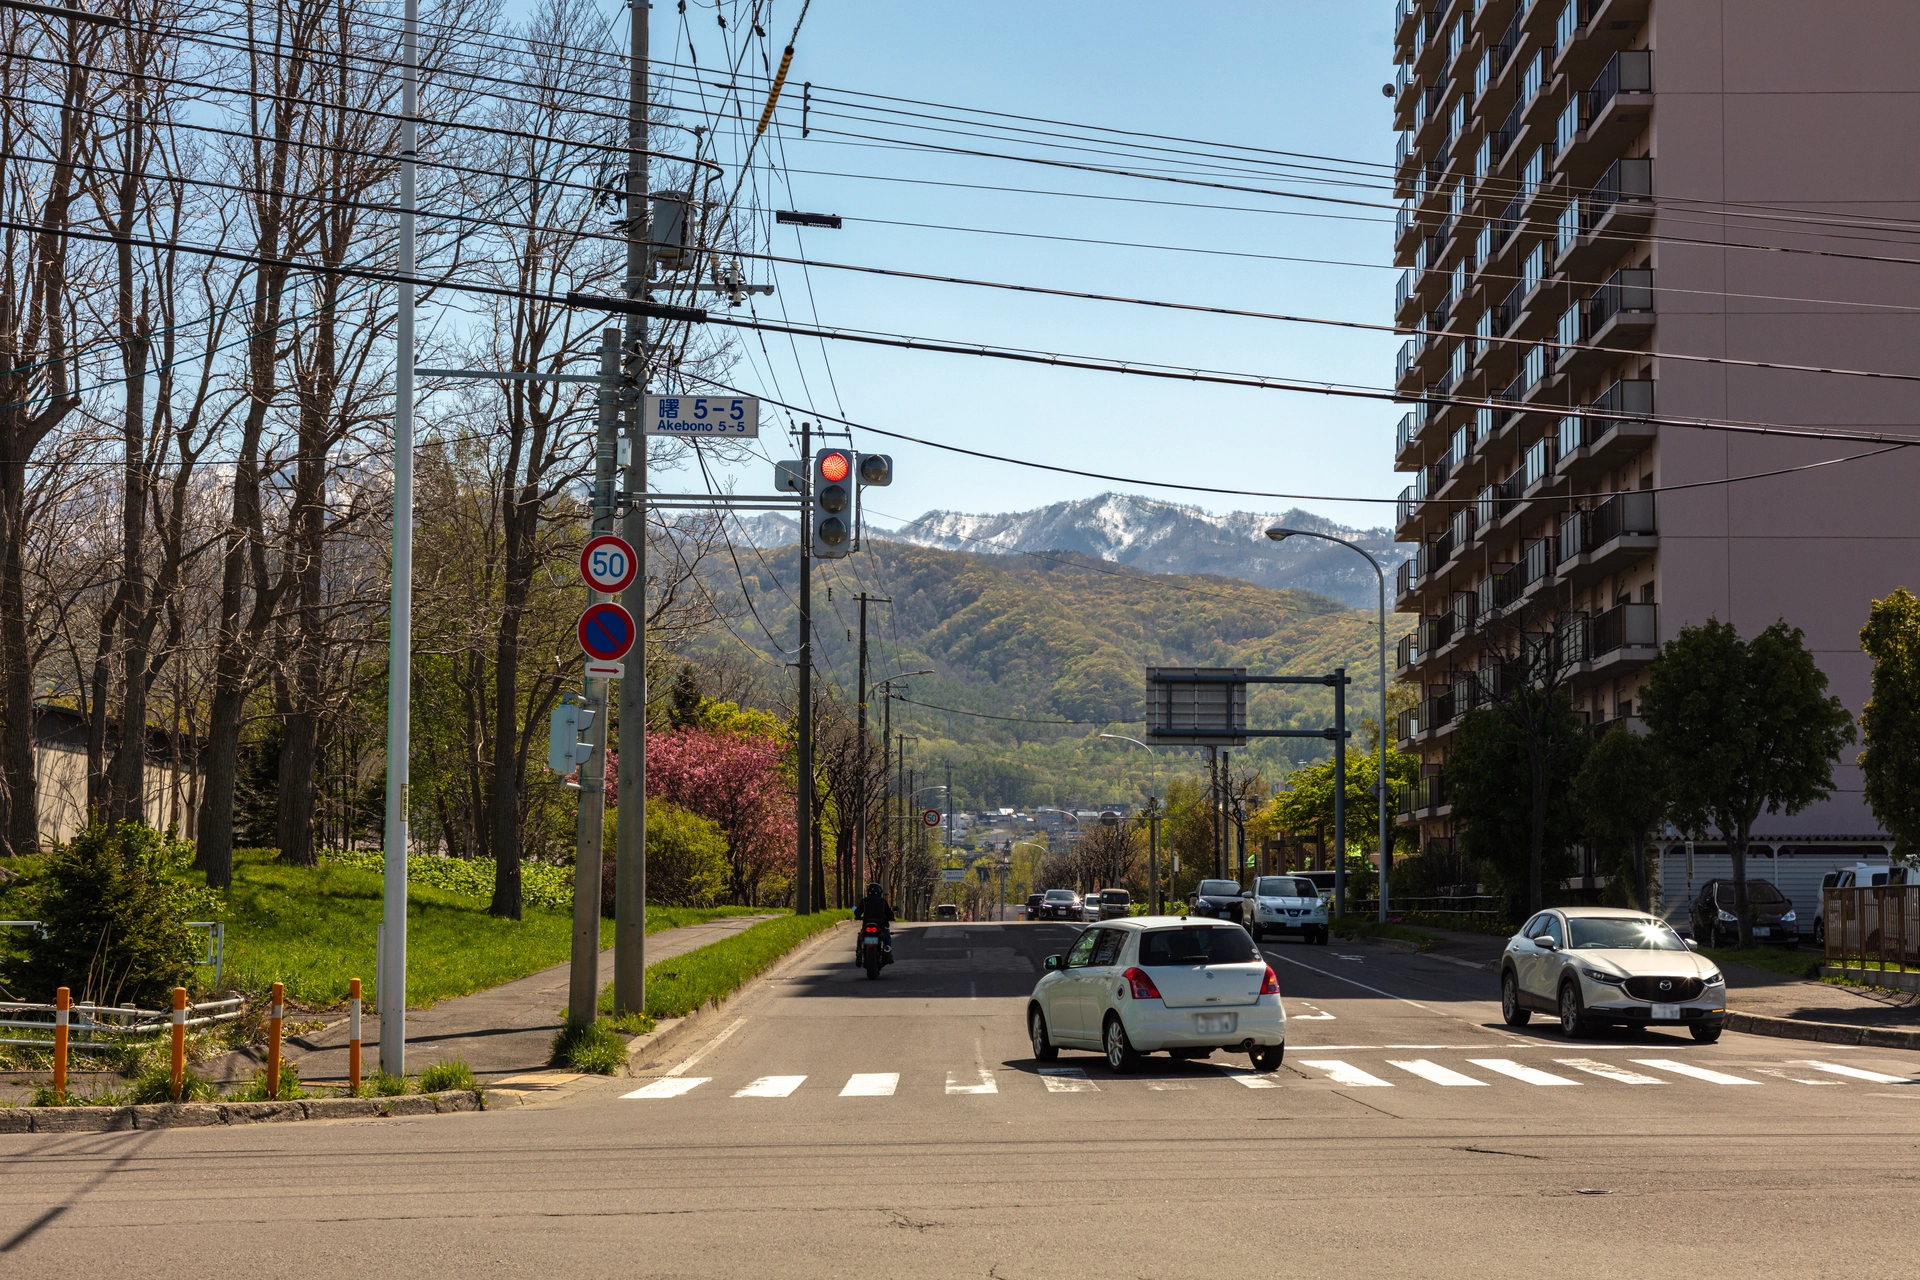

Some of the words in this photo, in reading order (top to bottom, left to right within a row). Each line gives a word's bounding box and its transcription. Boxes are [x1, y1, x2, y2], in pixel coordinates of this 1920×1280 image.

[659, 399, 679, 418] 曙
[694, 399, 744, 420] 5-5
[657, 420, 713, 431] Akebono
[718, 421, 745, 432] 5-5
[593, 551, 624, 577] 50
[927, 814, 937, 822] 50
